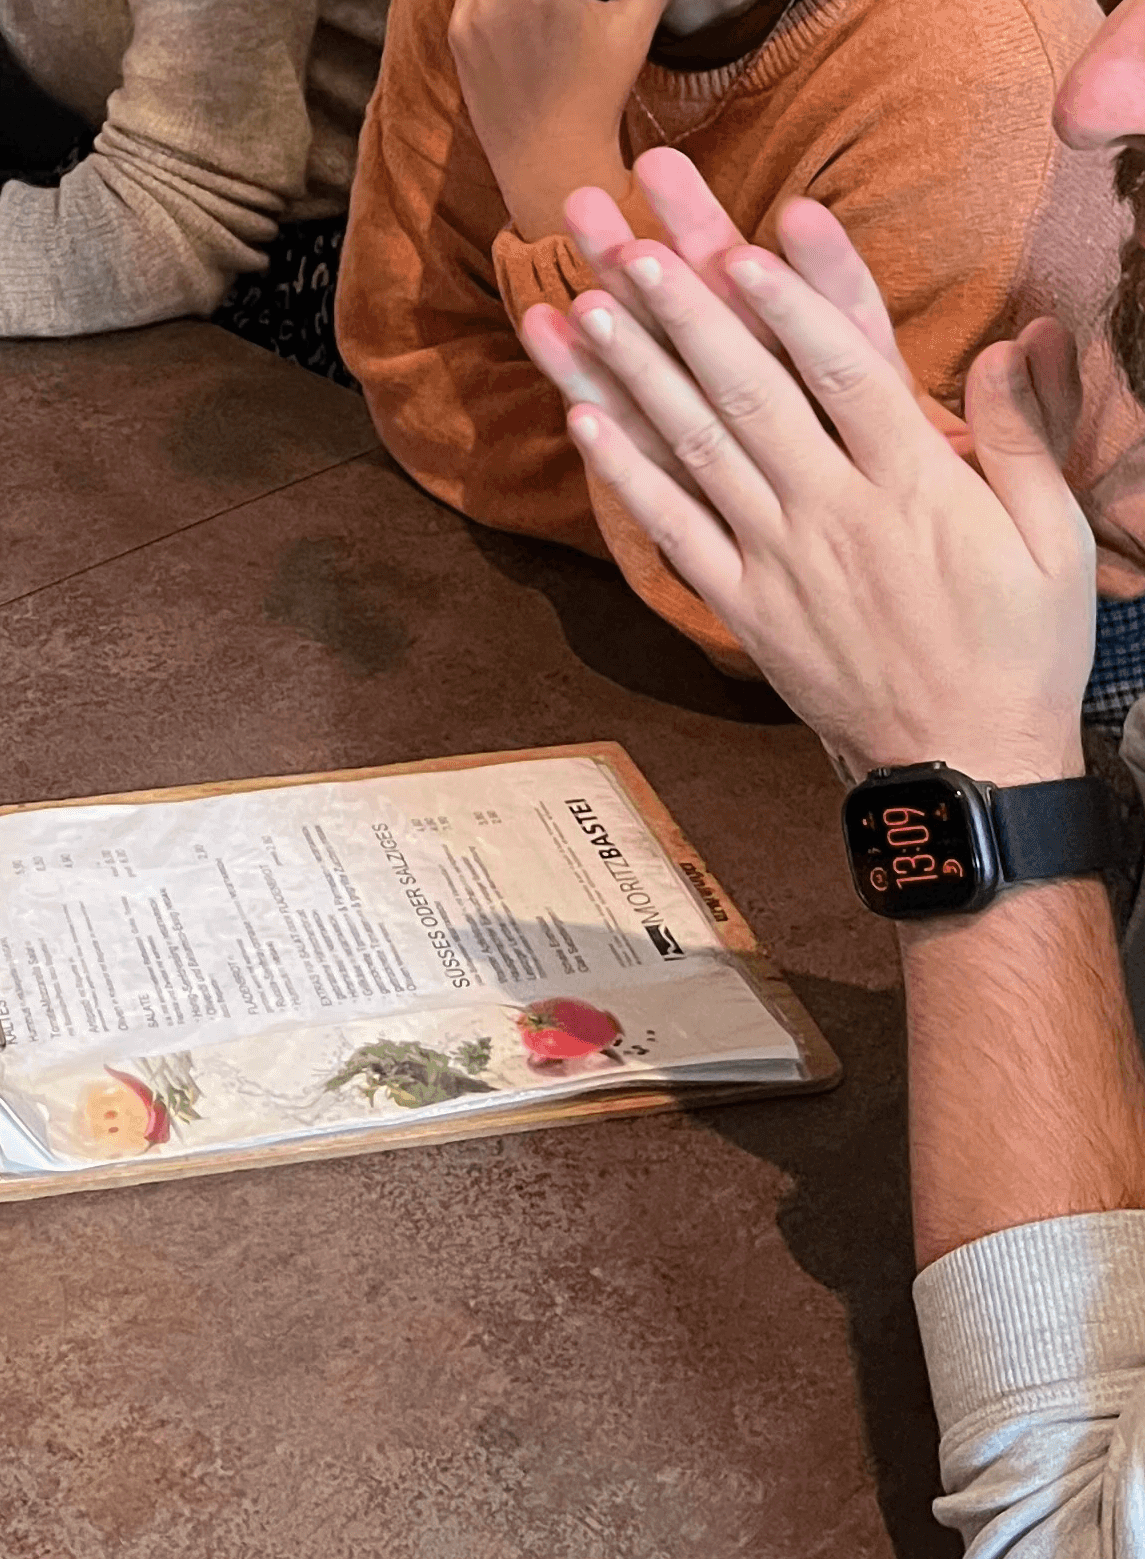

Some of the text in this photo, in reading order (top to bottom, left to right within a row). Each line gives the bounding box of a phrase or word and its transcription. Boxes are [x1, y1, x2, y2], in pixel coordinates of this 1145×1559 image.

[368, 822, 419, 885] SALZIGES
[559, 797, 669, 924] MORITZBASTEI
[882, 807, 939, 890] 13:09
[402, 887, 441, 927] ODER
[422, 929, 473, 988] SÜSSES
